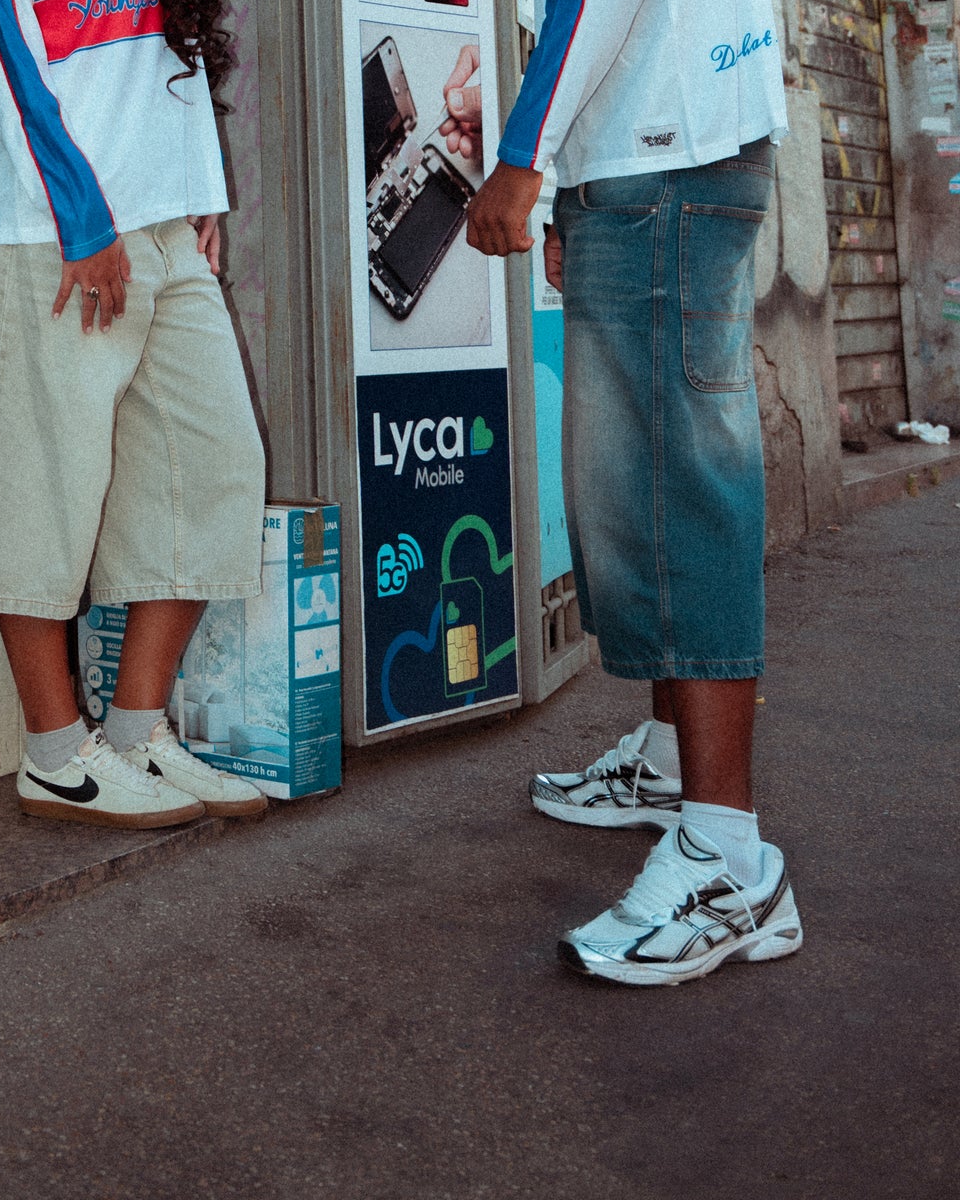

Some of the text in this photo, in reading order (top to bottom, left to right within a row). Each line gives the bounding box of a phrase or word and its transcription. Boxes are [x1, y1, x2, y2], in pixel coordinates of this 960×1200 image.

[373, 412, 464, 476] Lyca
[415, 465, 465, 489] Mobile
[378, 554, 407, 594] 5G
[106, 674, 112, 684] 3
[232, 762, 258, 775] 40x130
[260, 766, 265, 775] h
[266, 768, 277, 777] cm
